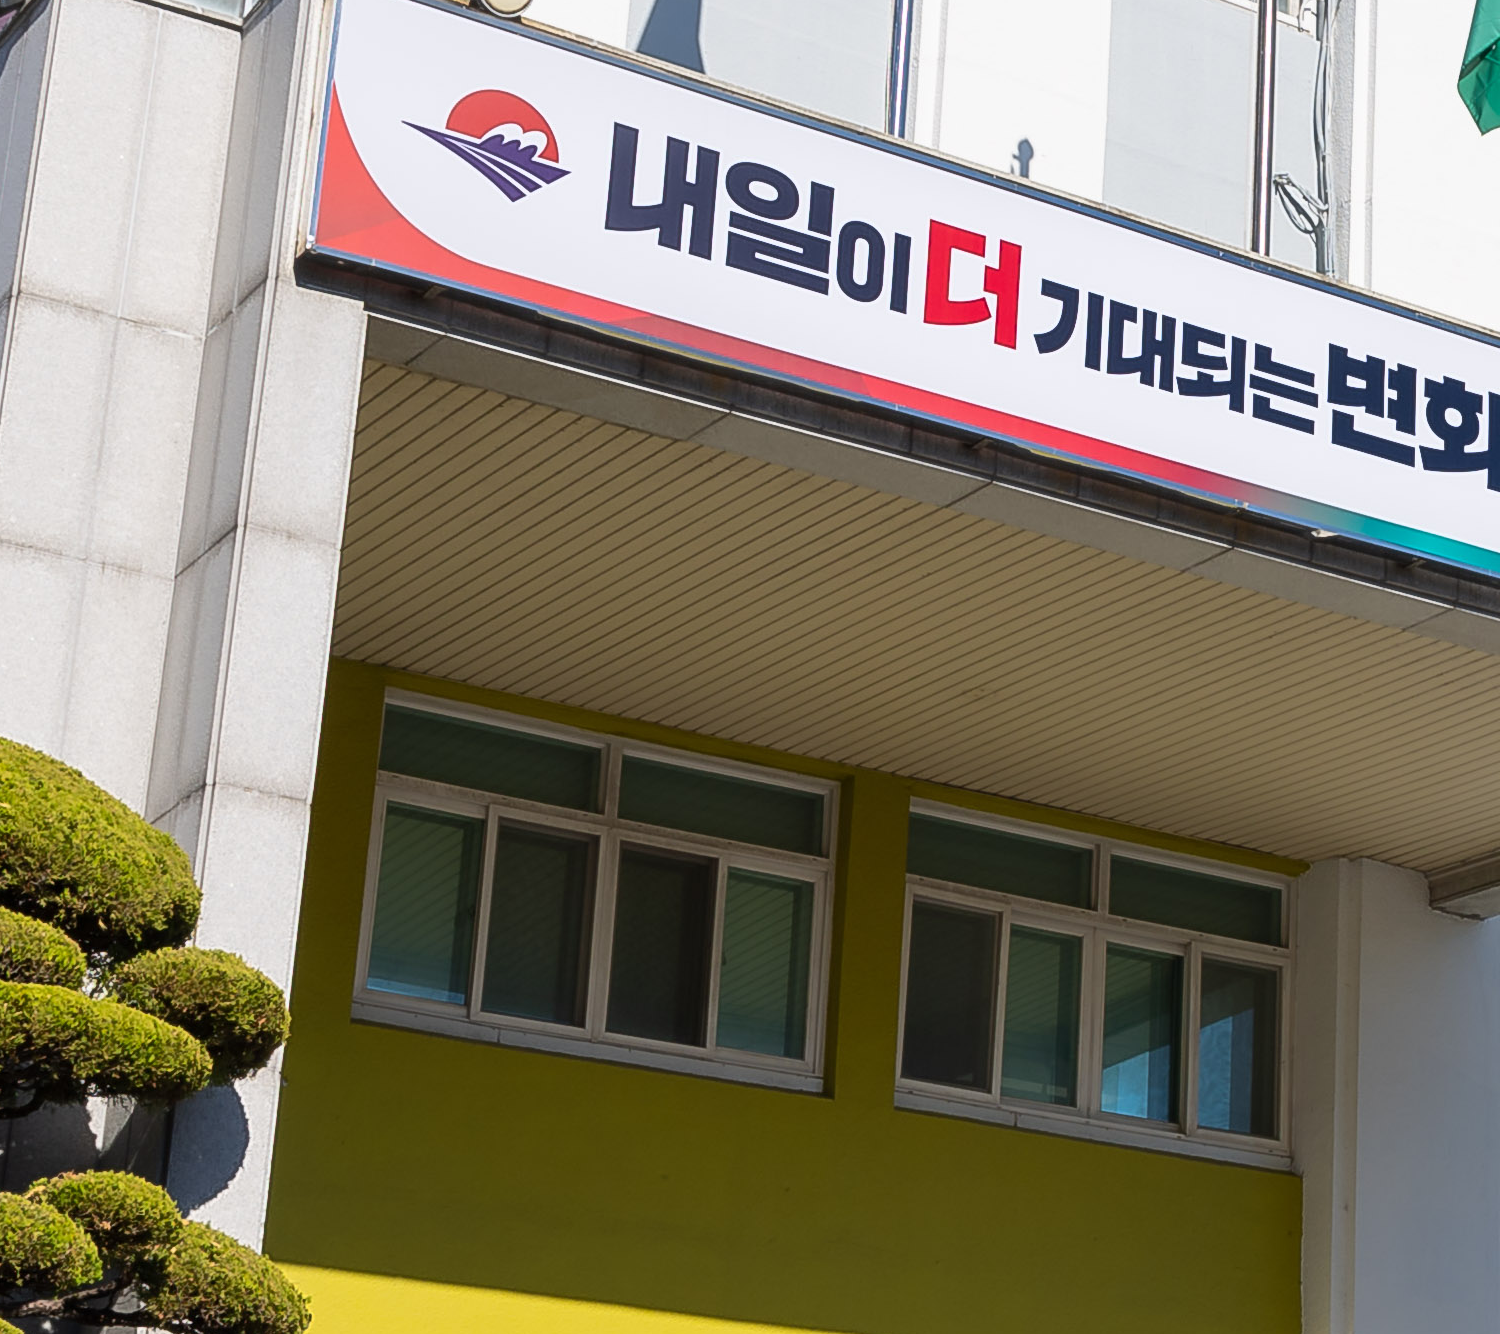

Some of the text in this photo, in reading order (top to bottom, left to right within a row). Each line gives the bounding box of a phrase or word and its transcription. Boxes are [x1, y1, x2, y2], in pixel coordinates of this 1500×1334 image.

[602, 119, 911, 315] 내일이
[923, 220, 1022, 350] 더
[1036, 276, 1320, 435] 기대되는
